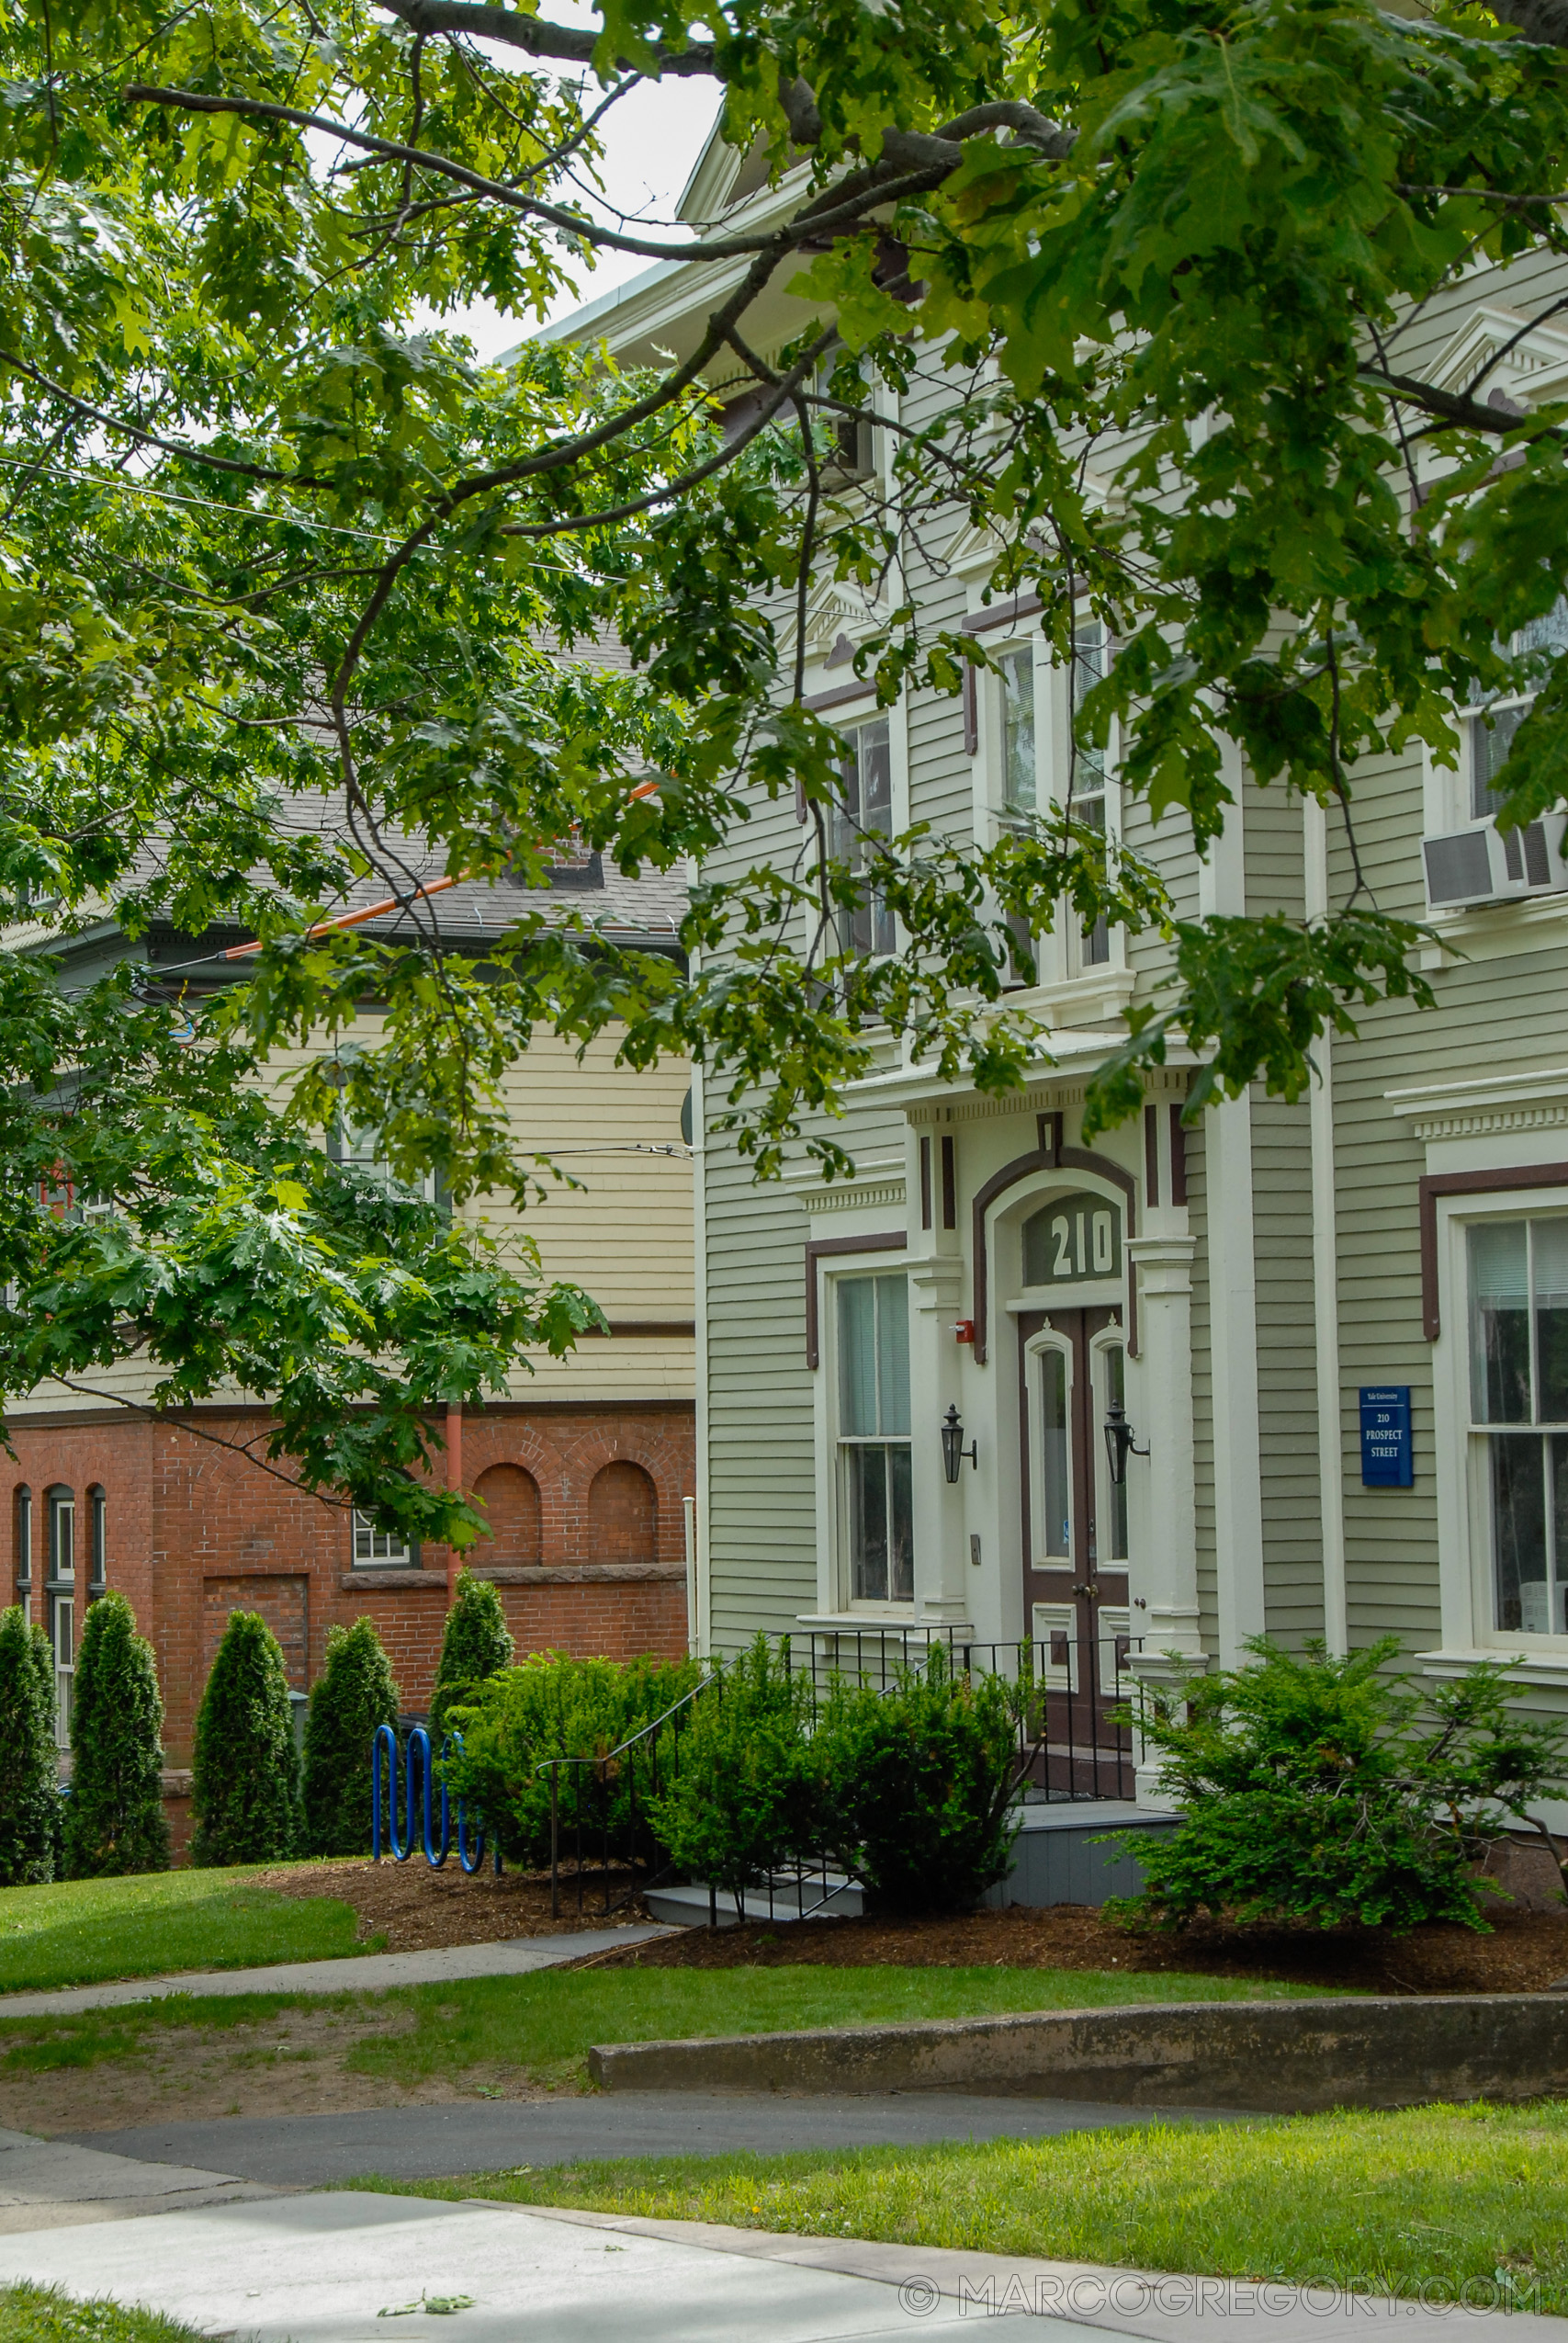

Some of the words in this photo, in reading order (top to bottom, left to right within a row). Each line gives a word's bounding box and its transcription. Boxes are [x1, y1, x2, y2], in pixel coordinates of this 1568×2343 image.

[1052, 1210, 1112, 1275] 210
[1377, 1413, 1390, 1423] 210
[1366, 1430, 1403, 1440] PROSPECT
[1371, 1447, 1398, 1457] STREET
